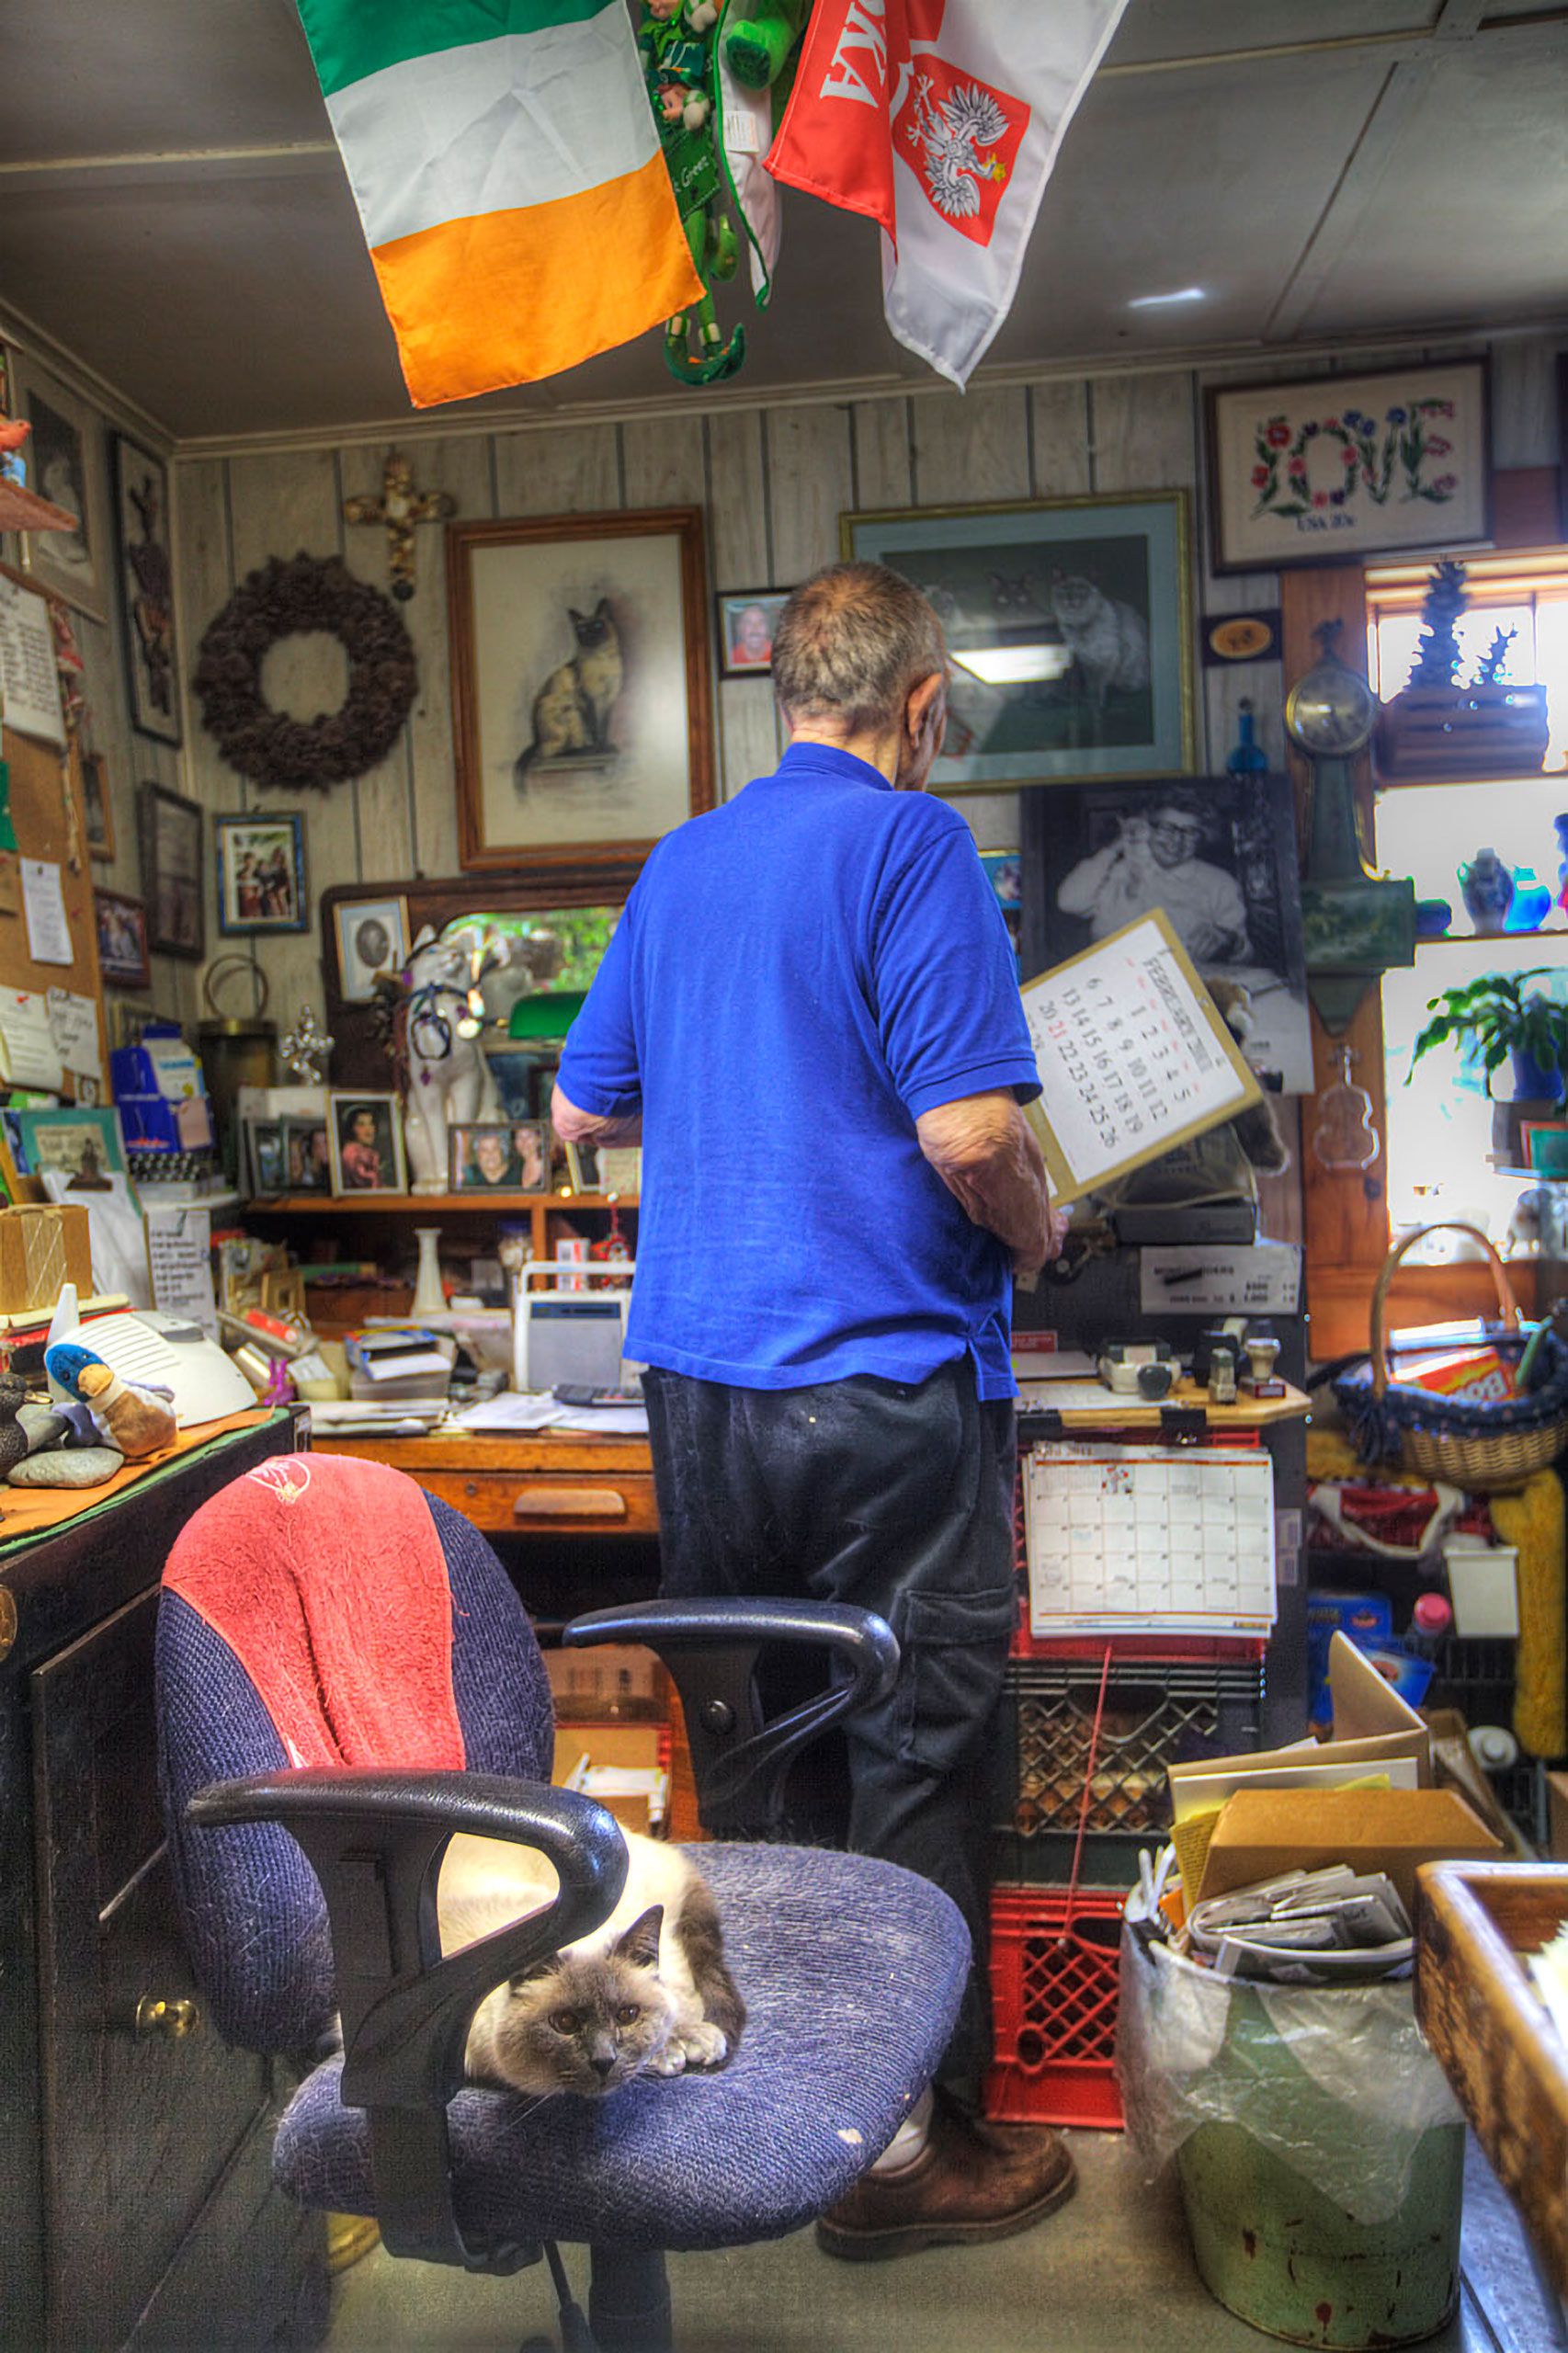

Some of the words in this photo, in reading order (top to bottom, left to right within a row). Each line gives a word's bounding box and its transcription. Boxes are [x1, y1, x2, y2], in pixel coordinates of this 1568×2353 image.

[1250, 397, 1458, 520] LOVE
[1039, 1000, 1058, 1020] 20
[1048, 1020, 1068, 1040] 21
[1058, 1040, 1079, 1062] 22
[1087, 978, 1102, 990] 6
[1097, 995, 1114, 1007] 7
[1107, 1017, 1124, 1032] 8
[1119, 1039, 1134, 1051] 9
[1127, 1057, 1147, 1078] 10
[1138, 1078, 1157, 1098] 11
[1149, 1099, 1168, 1121] 12
[1130, 1005, 1147, 1017] 1
[1141, 1025, 1159, 1040] 2
[1152, 1045, 1170, 1060] 3
[1163, 1068, 1179, 1083] 4
[1173, 1088, 1191, 1101] 5
[1062, 988, 1081, 1006] 13
[1072, 1007, 1090, 1027] 14
[1082, 1029, 1103, 1048] 15
[1093, 1050, 1112, 1070] 16
[1103, 1071, 1123, 1089] 17
[1114, 1093, 1133, 1113] 18
[1124, 1112, 1143, 1134] 19
[1068, 1062, 1088, 1083] 23
[1078, 1083, 1098, 1104] 24
[1089, 1105, 1110, 1124] 25
[1099, 1126, 1118, 1148] 26
